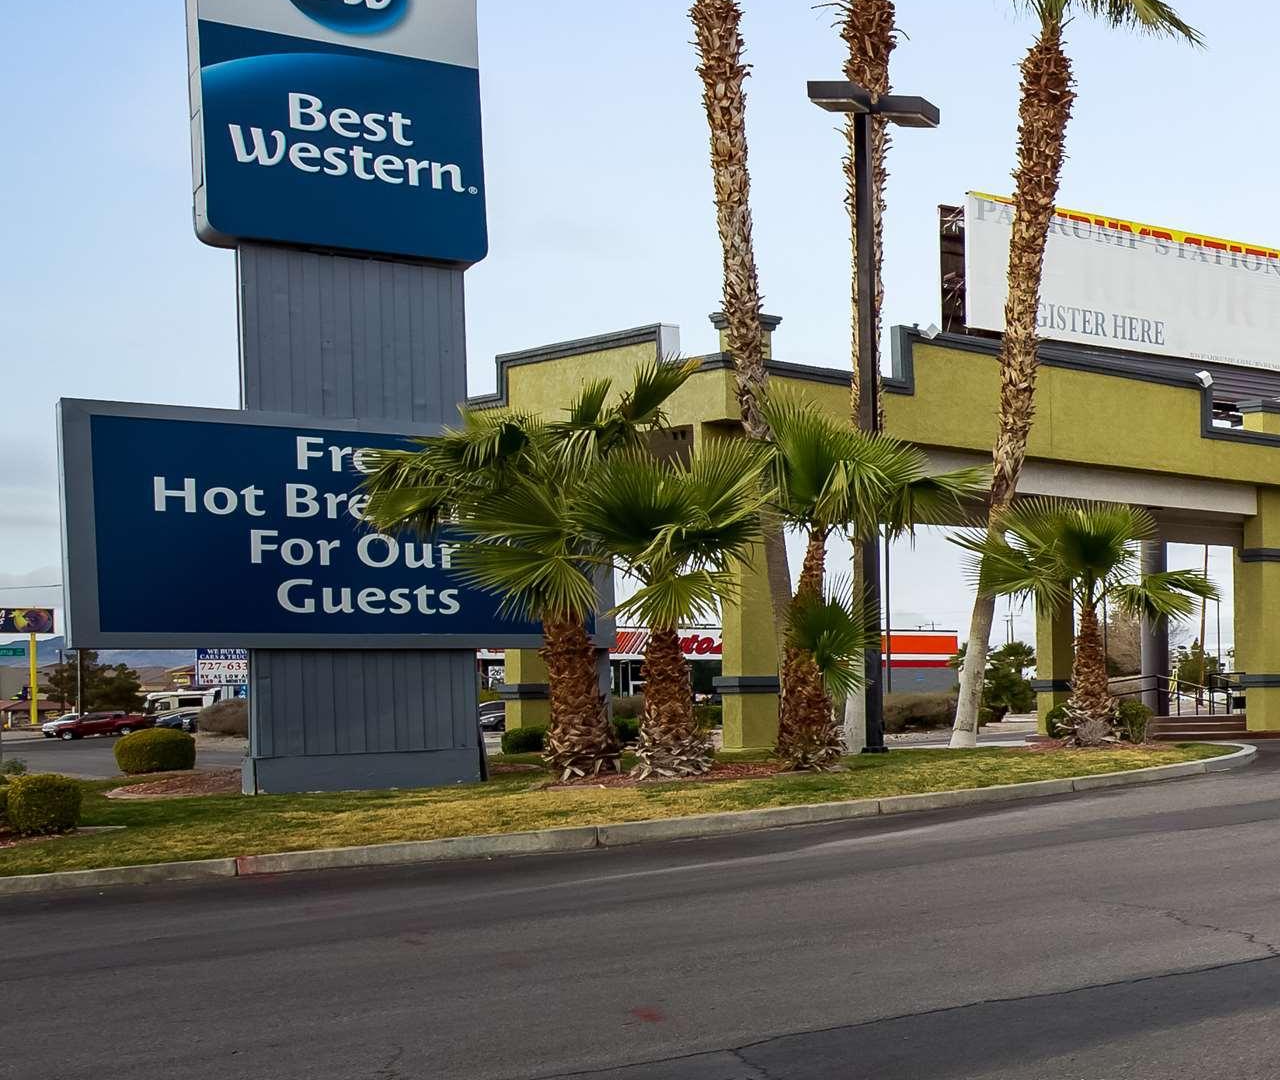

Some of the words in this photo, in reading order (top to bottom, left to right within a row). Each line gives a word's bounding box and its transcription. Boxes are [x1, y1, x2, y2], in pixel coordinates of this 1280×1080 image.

[288, 92, 414, 146] Best
[974, 196, 1148, 252] PARUMP
[1036, 301, 1107, 337] GISTER
[1111, 313, 1165, 346] HERE
[153, 476, 267, 516] Hot
[250, 529, 340, 566] For
[356, 532, 461, 569] Our
[276, 578, 461, 615] Guests
[200, 662, 248, 671] 727-633
